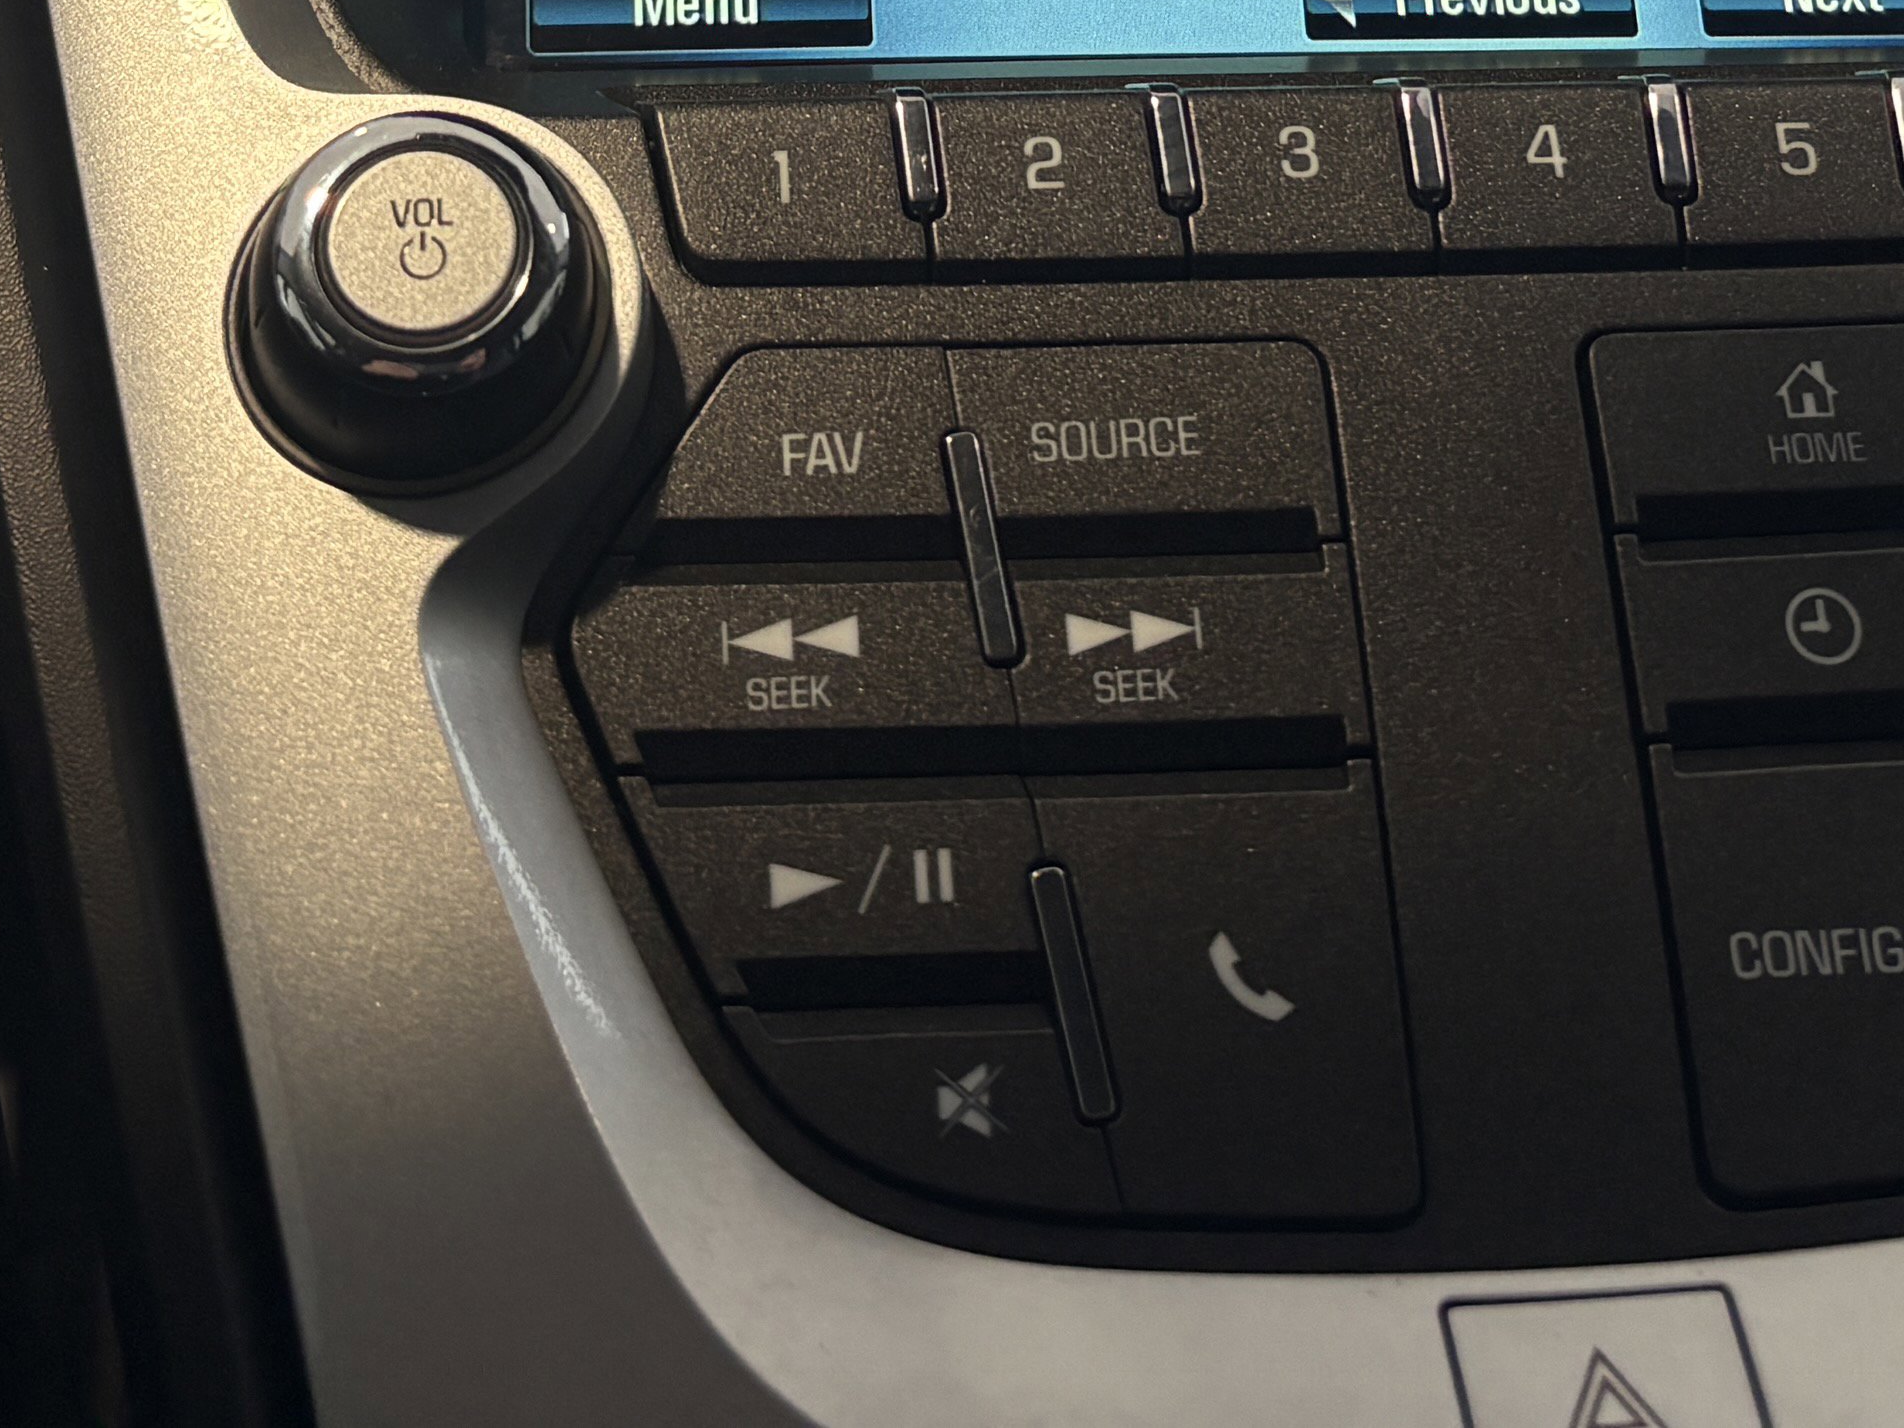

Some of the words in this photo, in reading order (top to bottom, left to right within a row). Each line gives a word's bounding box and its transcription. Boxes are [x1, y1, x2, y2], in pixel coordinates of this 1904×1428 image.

[1024, 135, 1063, 190] 2
[1278, 125, 1319, 179] 3
[1526, 124, 1569, 178] 4
[1777, 122, 1818, 177] 5
[770, 149, 793, 205] 1
[390, 198, 454, 229] VOL
[781, 431, 864, 477] FAV
[1029, 415, 1201, 464] SOURCE
[1767, 429, 1869, 465] HOME
[746, 675, 833, 711] SEEK
[1093, 668, 1179, 704] SEEK
